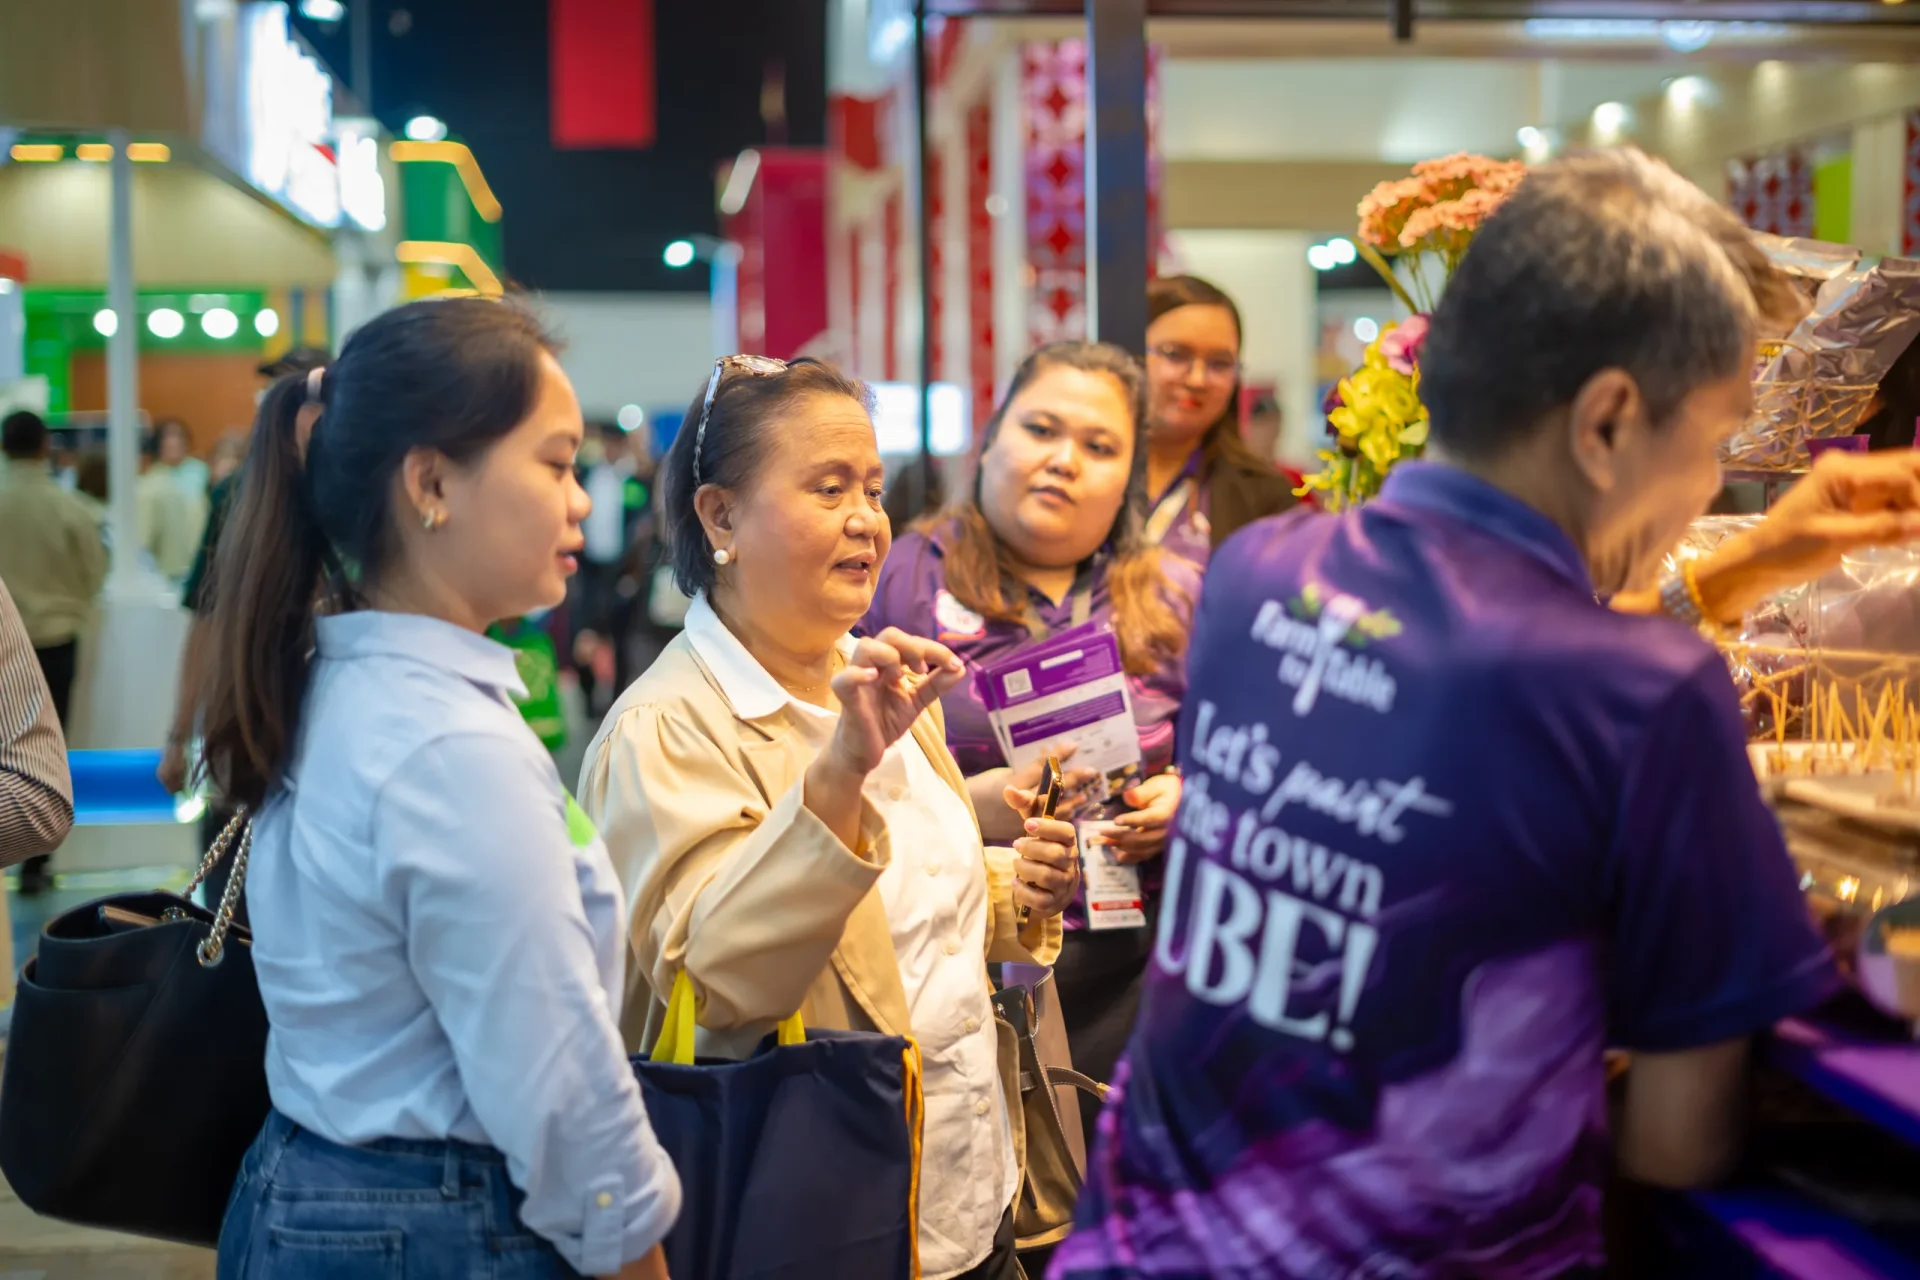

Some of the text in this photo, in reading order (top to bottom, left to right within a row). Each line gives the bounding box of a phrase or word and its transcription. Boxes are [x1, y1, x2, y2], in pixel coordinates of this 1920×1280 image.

[1251, 599, 1319, 656] Farm
[1278, 647, 1396, 712] to Table
[1192, 700, 1454, 843] Let's paint
[1231, 808, 1383, 917] town
[1155, 836, 1379, 1053] UBE!
